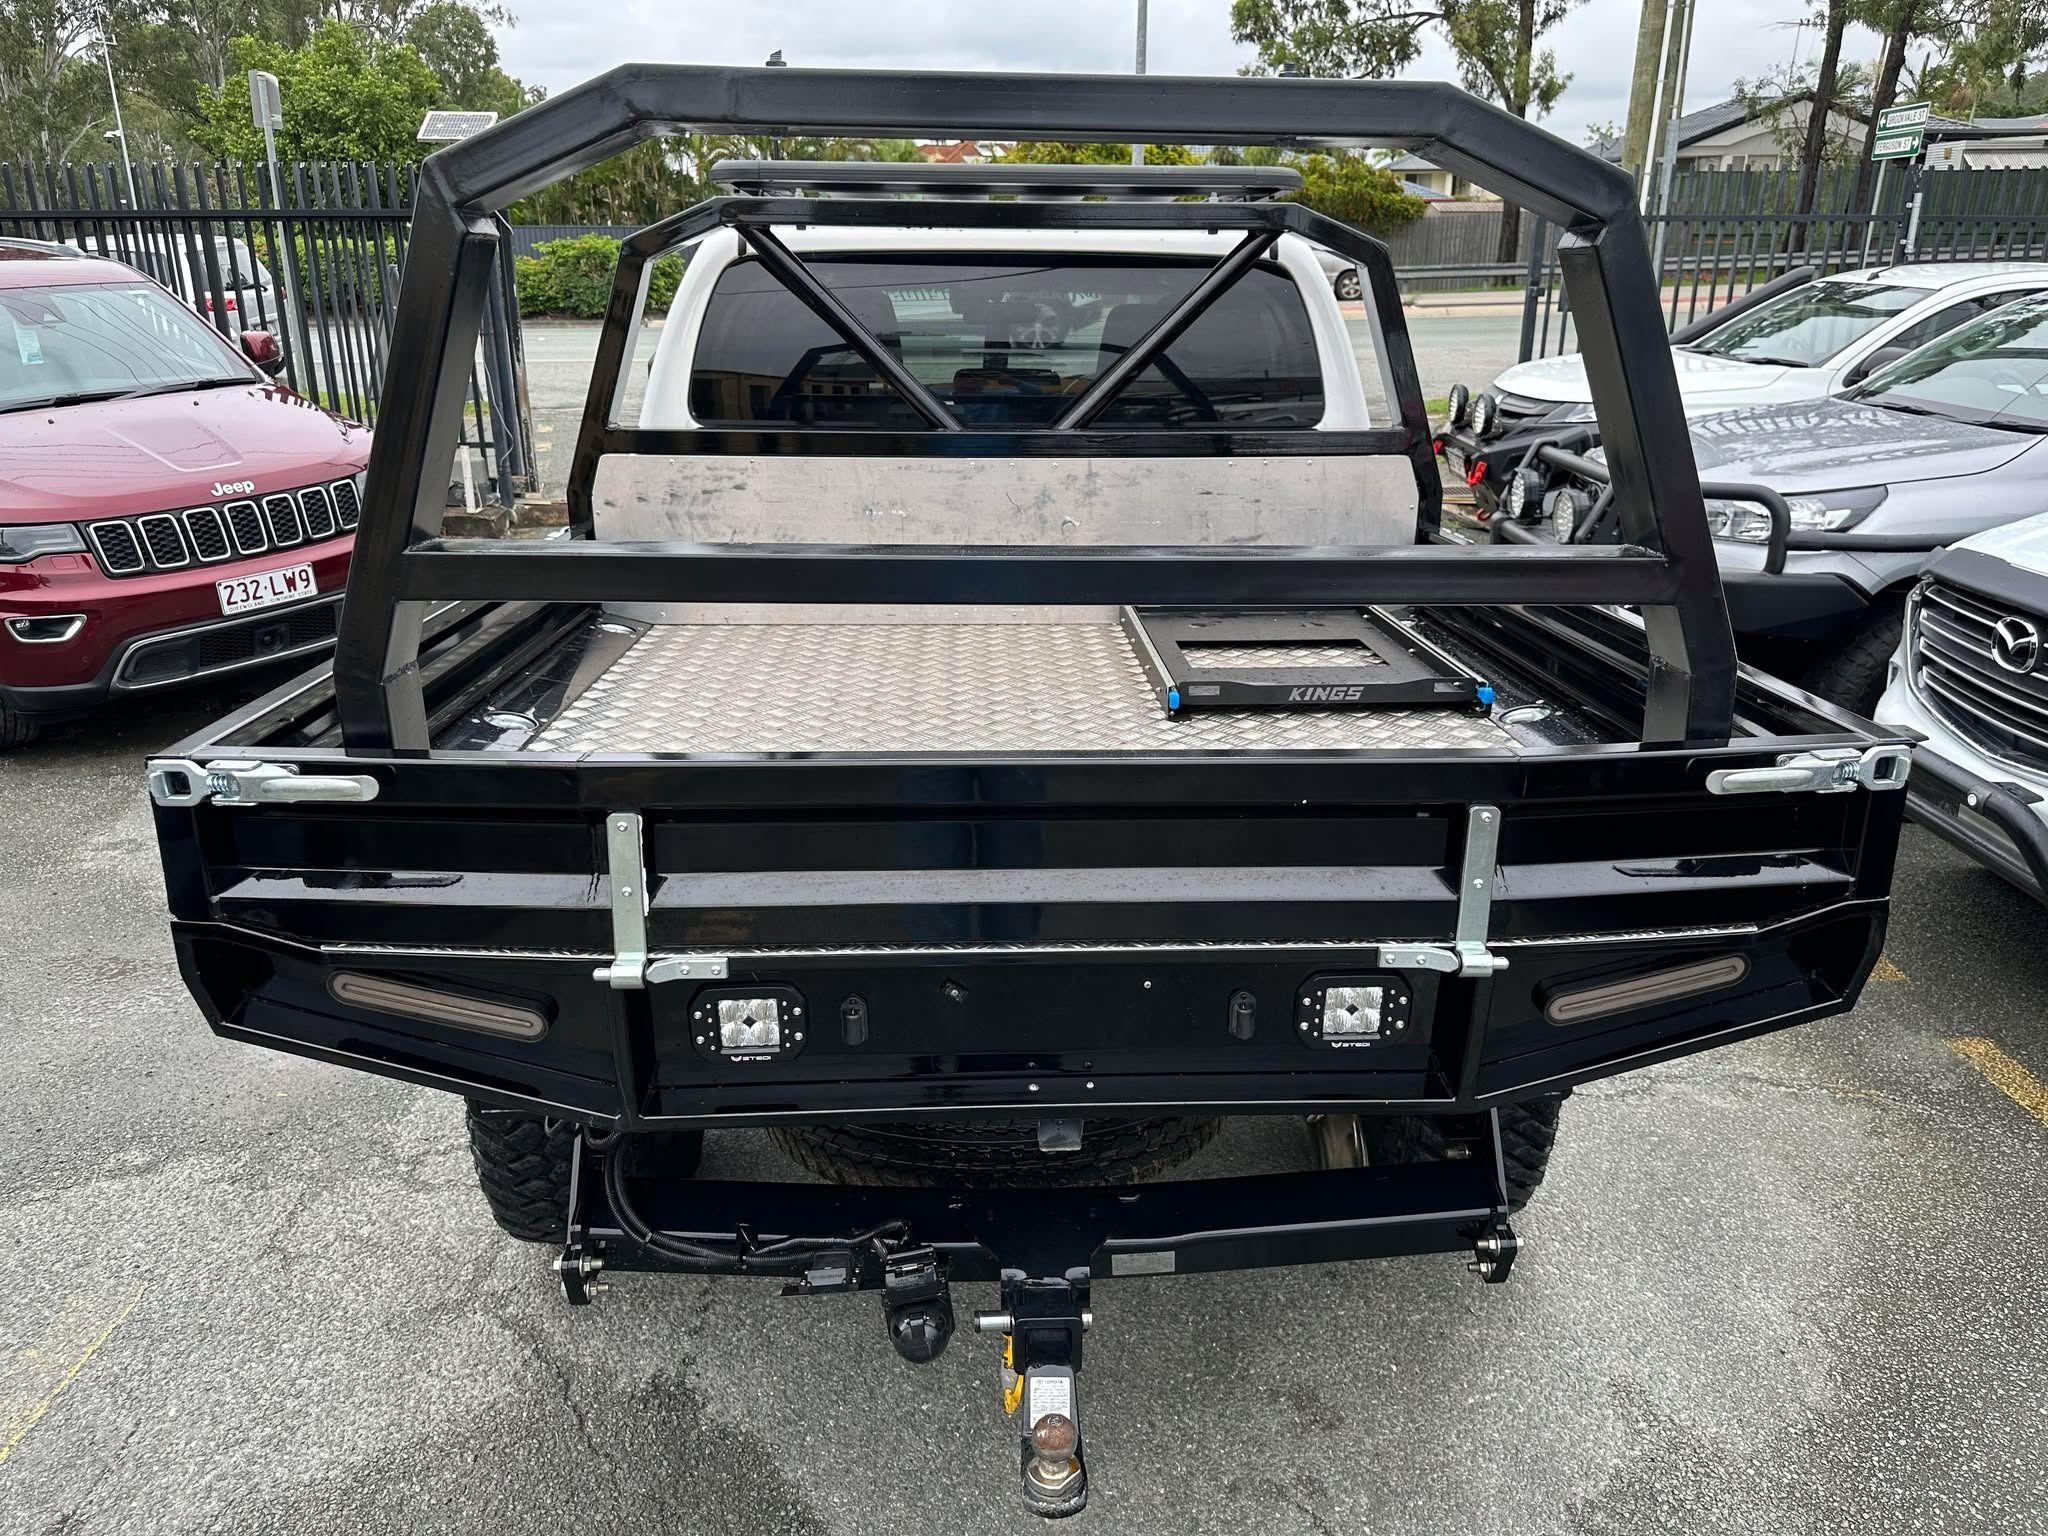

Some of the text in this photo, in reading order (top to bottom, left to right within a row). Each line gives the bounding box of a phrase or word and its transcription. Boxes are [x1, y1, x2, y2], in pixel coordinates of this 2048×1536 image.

[1888, 111, 1918, 125] BROOKVALE
[1876, 140, 1902, 152] FERGUSON
[211, 480, 255, 496] Jeep
[1288, 686, 1365, 701] KINGS
